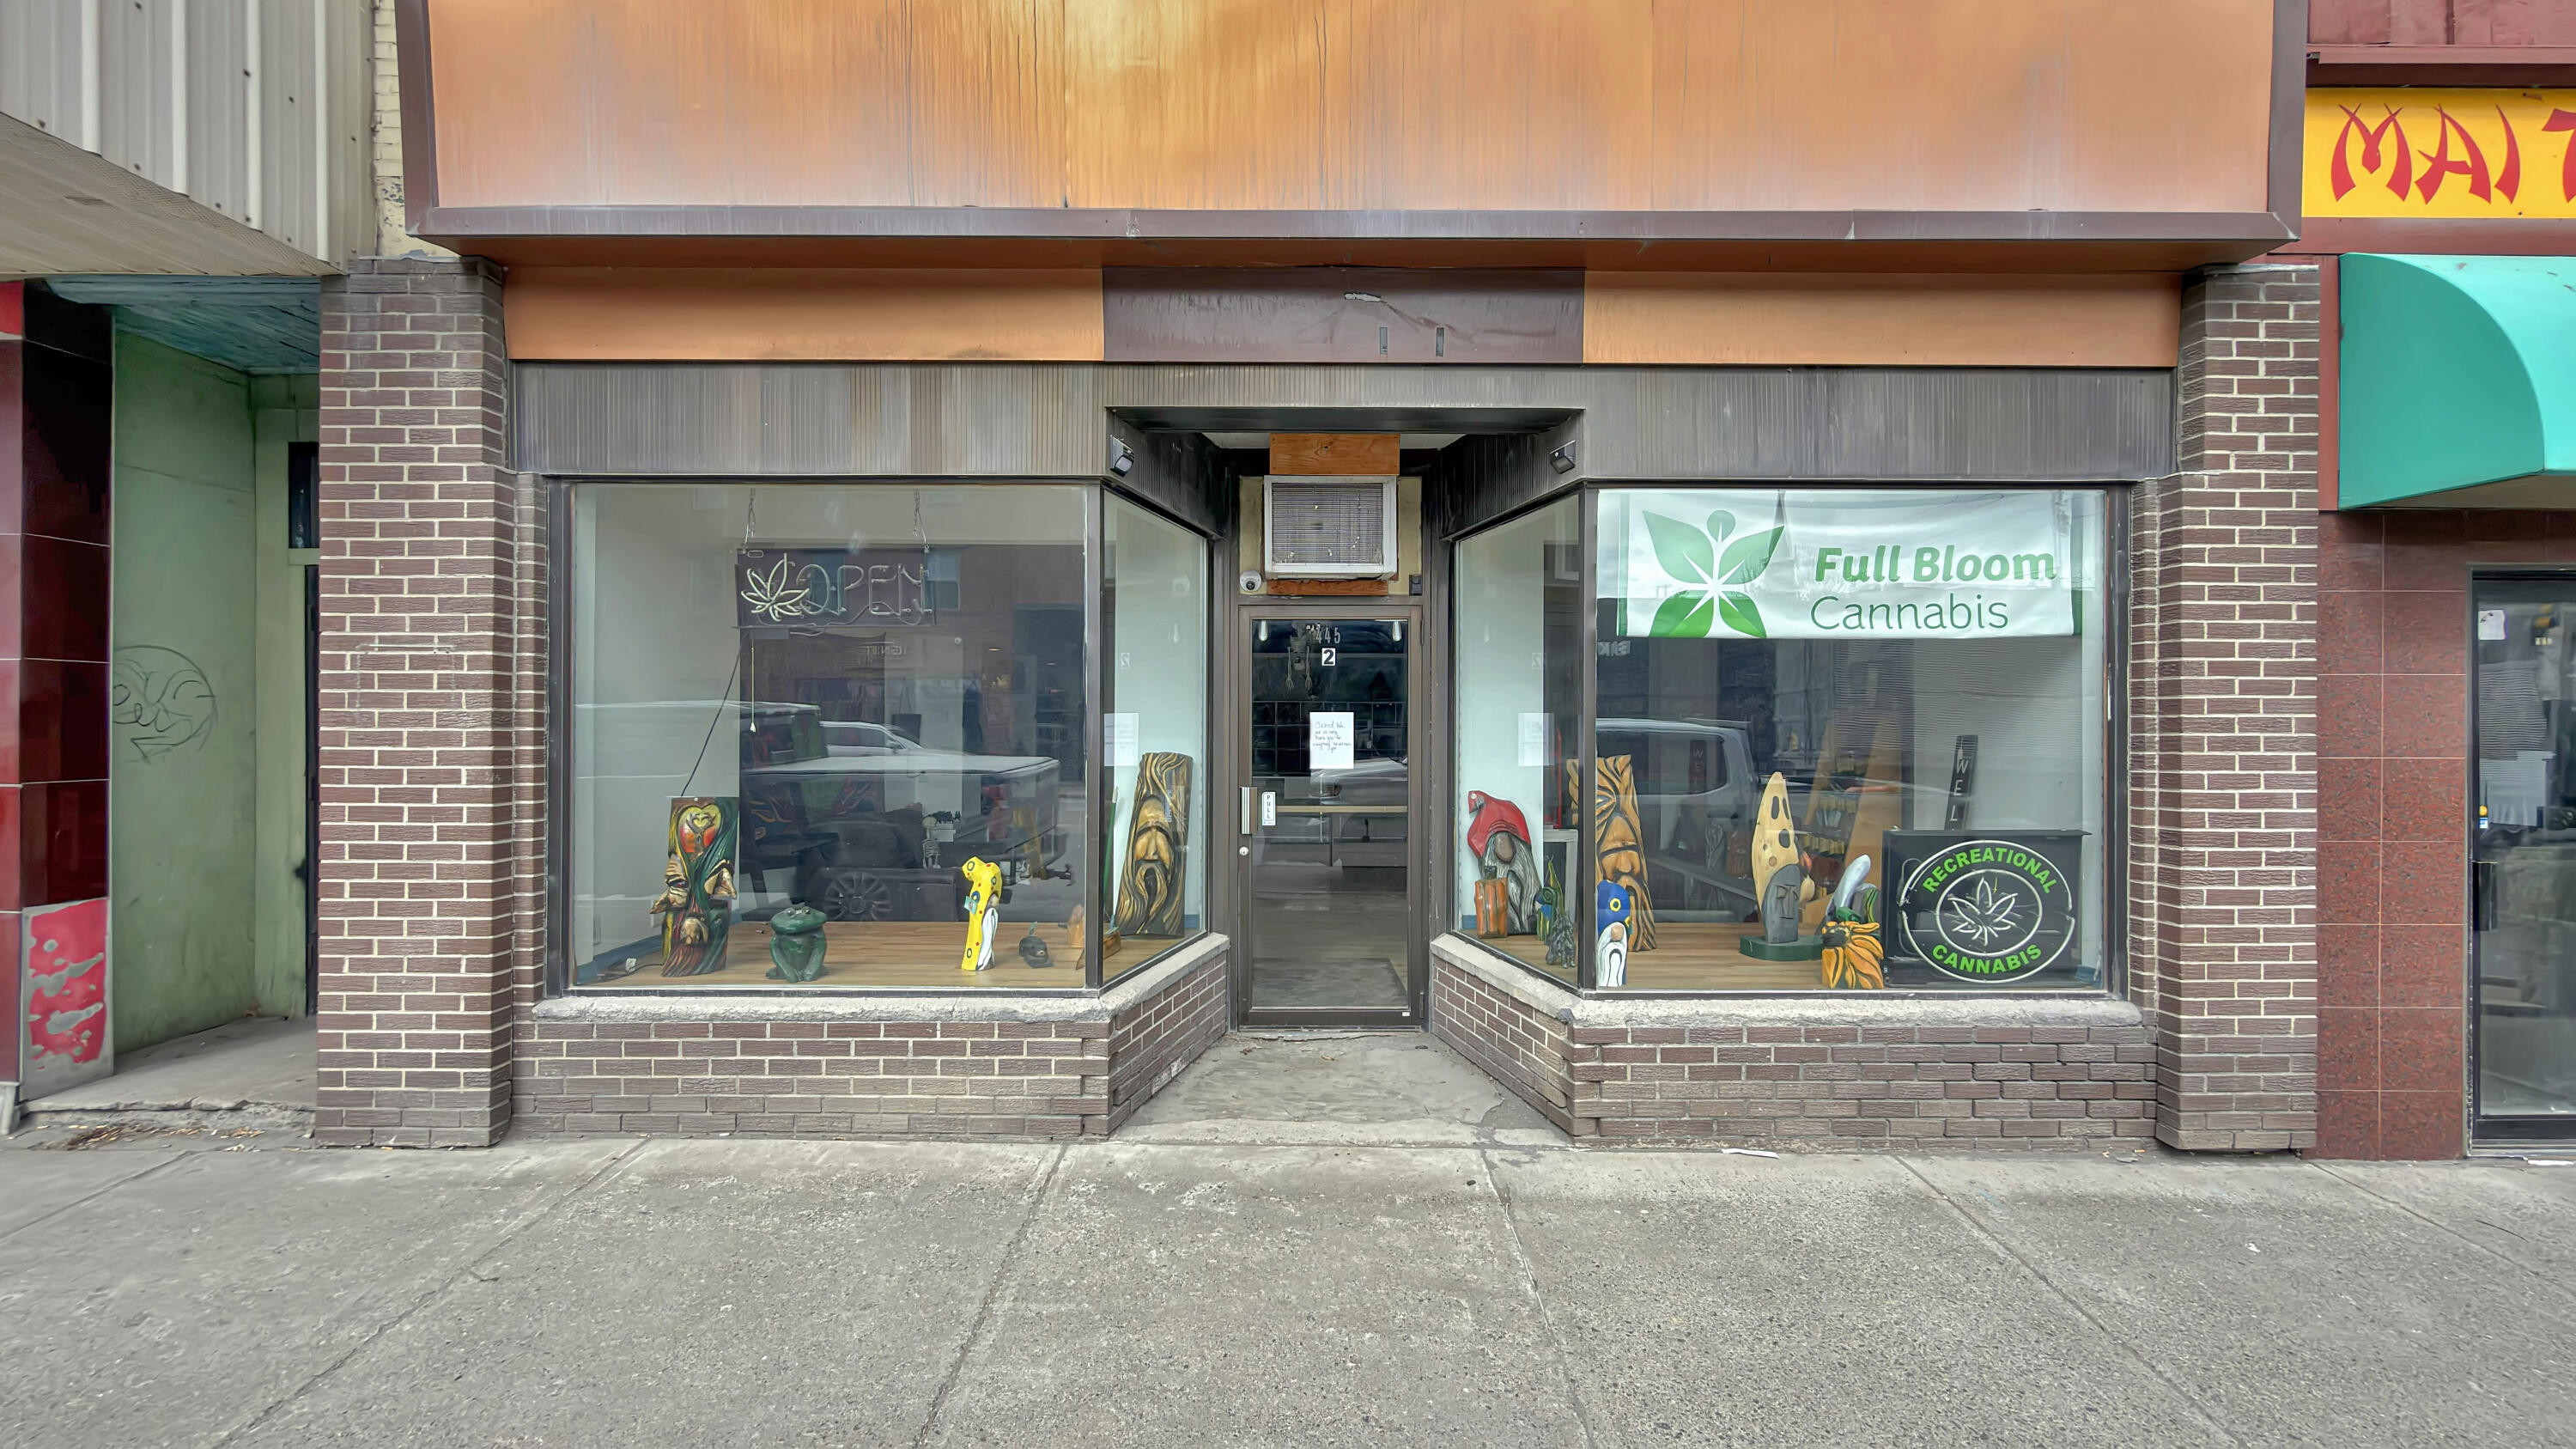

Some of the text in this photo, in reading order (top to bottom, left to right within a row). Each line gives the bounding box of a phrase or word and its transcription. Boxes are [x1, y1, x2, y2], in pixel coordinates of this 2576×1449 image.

[2330, 102, 2521, 204] MAI
[1814, 545, 2057, 582] Full Bloom
[796, 563, 926, 615] OPEN
[1810, 594, 2008, 630] Cannabis
[1323, 649, 1334, 665] 2
[1949, 759, 1969, 831] WEL
[1923, 847, 2057, 894] RECREATIONAL
[1932, 944, 2042, 974] CANNABIS
